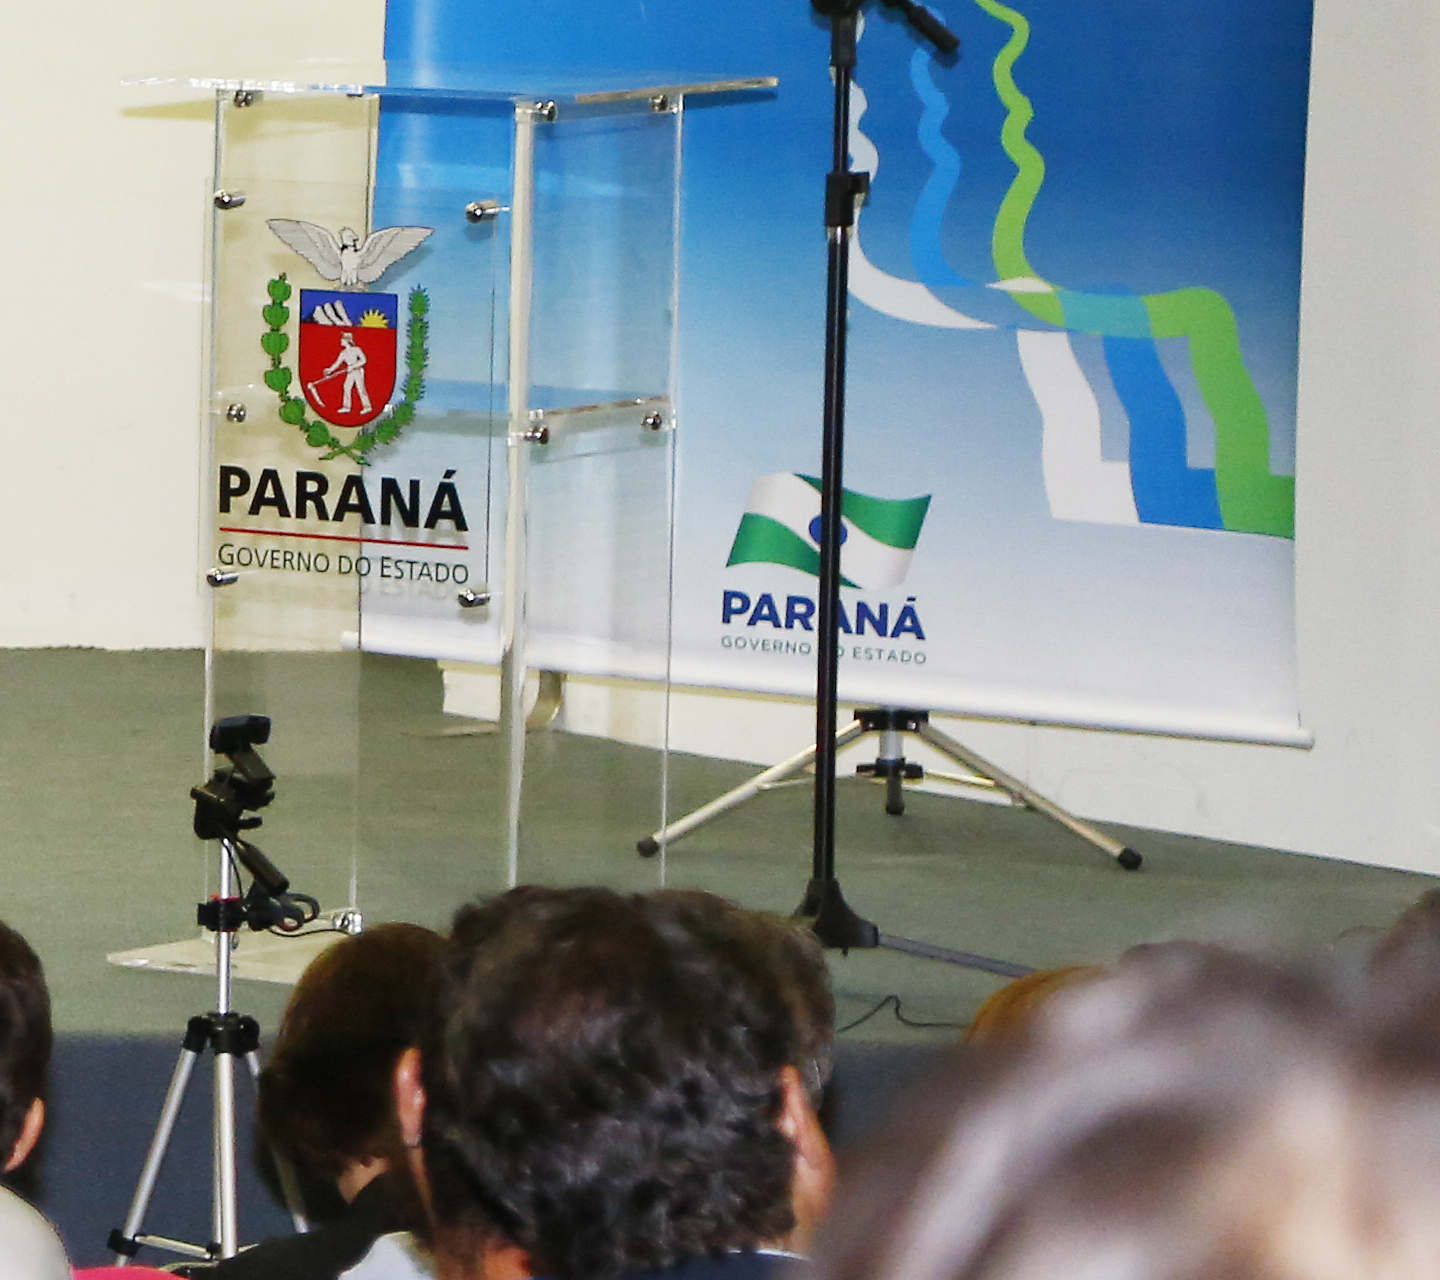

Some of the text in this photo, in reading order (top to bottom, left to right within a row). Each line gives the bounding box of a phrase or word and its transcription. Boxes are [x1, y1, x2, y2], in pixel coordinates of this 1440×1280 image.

[218, 464, 469, 532] PARANÁ
[218, 543, 469, 584] GOVERNO DO ESTADO
[721, 635, 811, 655] GOVERNO
[852, 646, 927, 665] ESTADO
